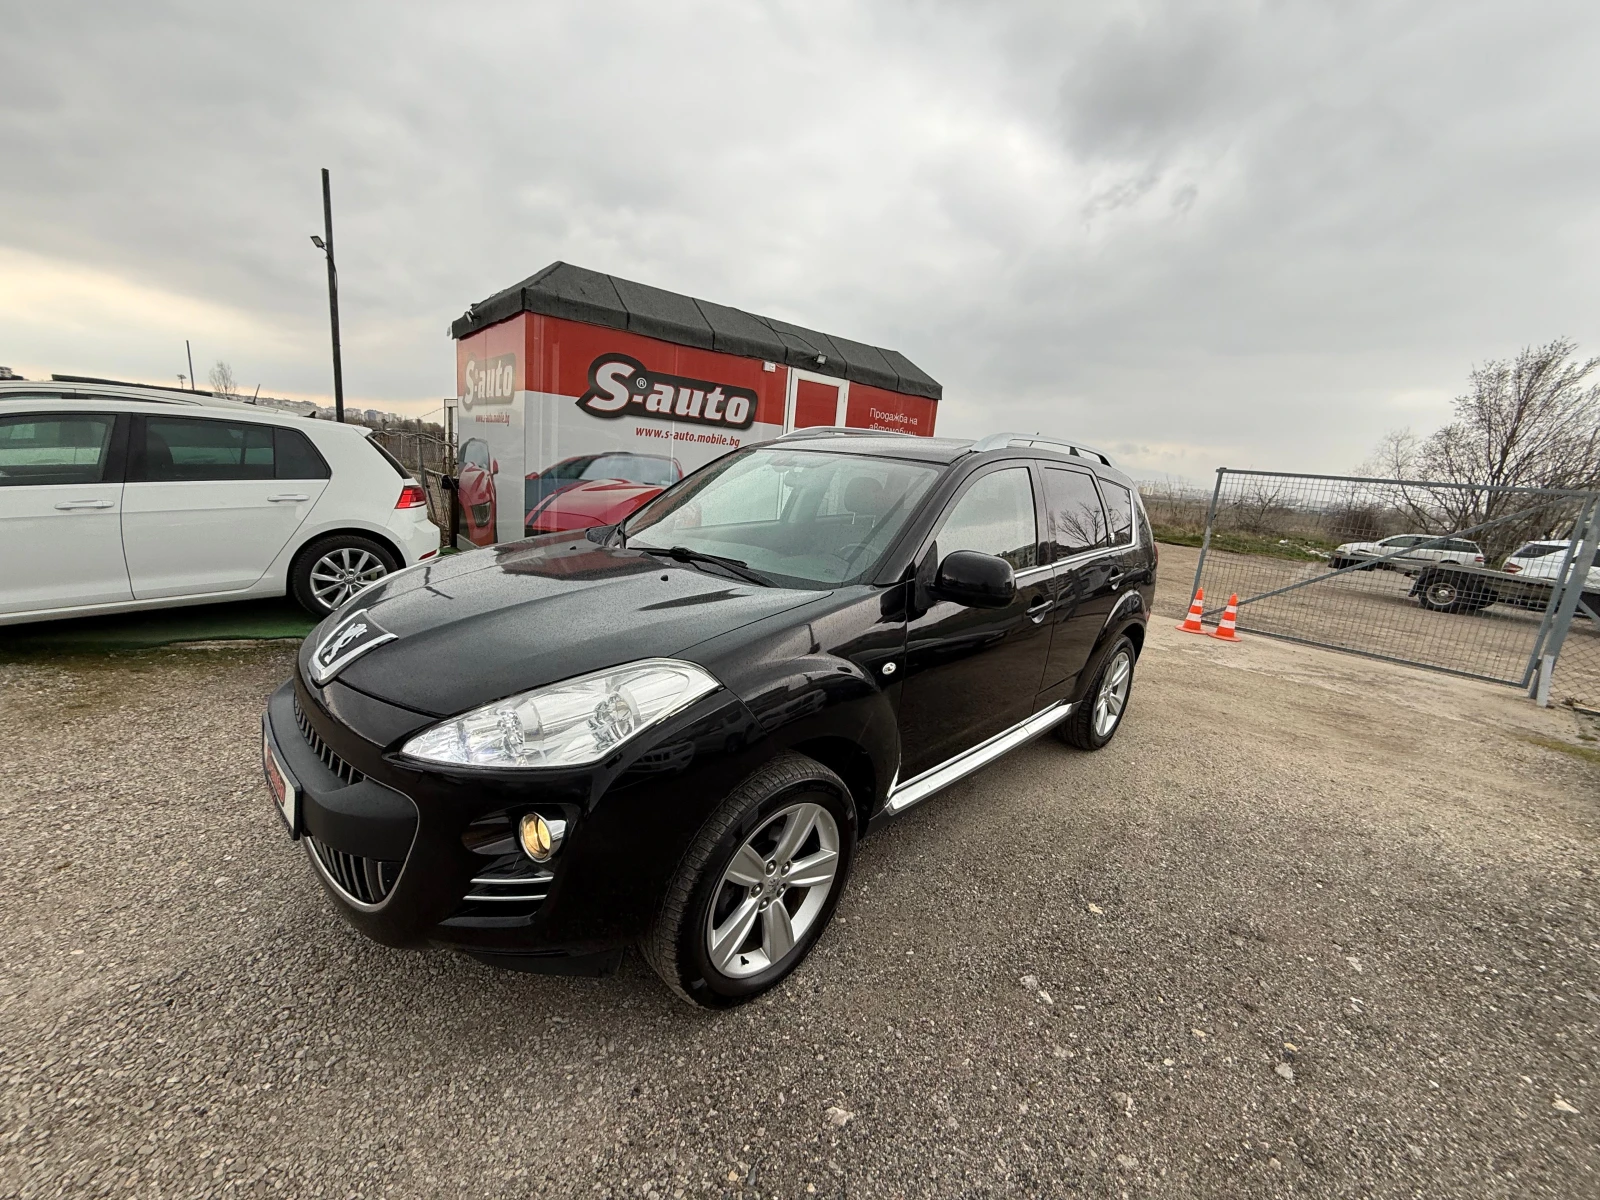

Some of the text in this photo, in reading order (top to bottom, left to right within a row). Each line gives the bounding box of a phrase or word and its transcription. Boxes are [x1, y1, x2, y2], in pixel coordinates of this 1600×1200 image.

[869, 407, 918, 426] Продажба на
[635, 427, 740, 448] www.s-auto.mobile.bg
